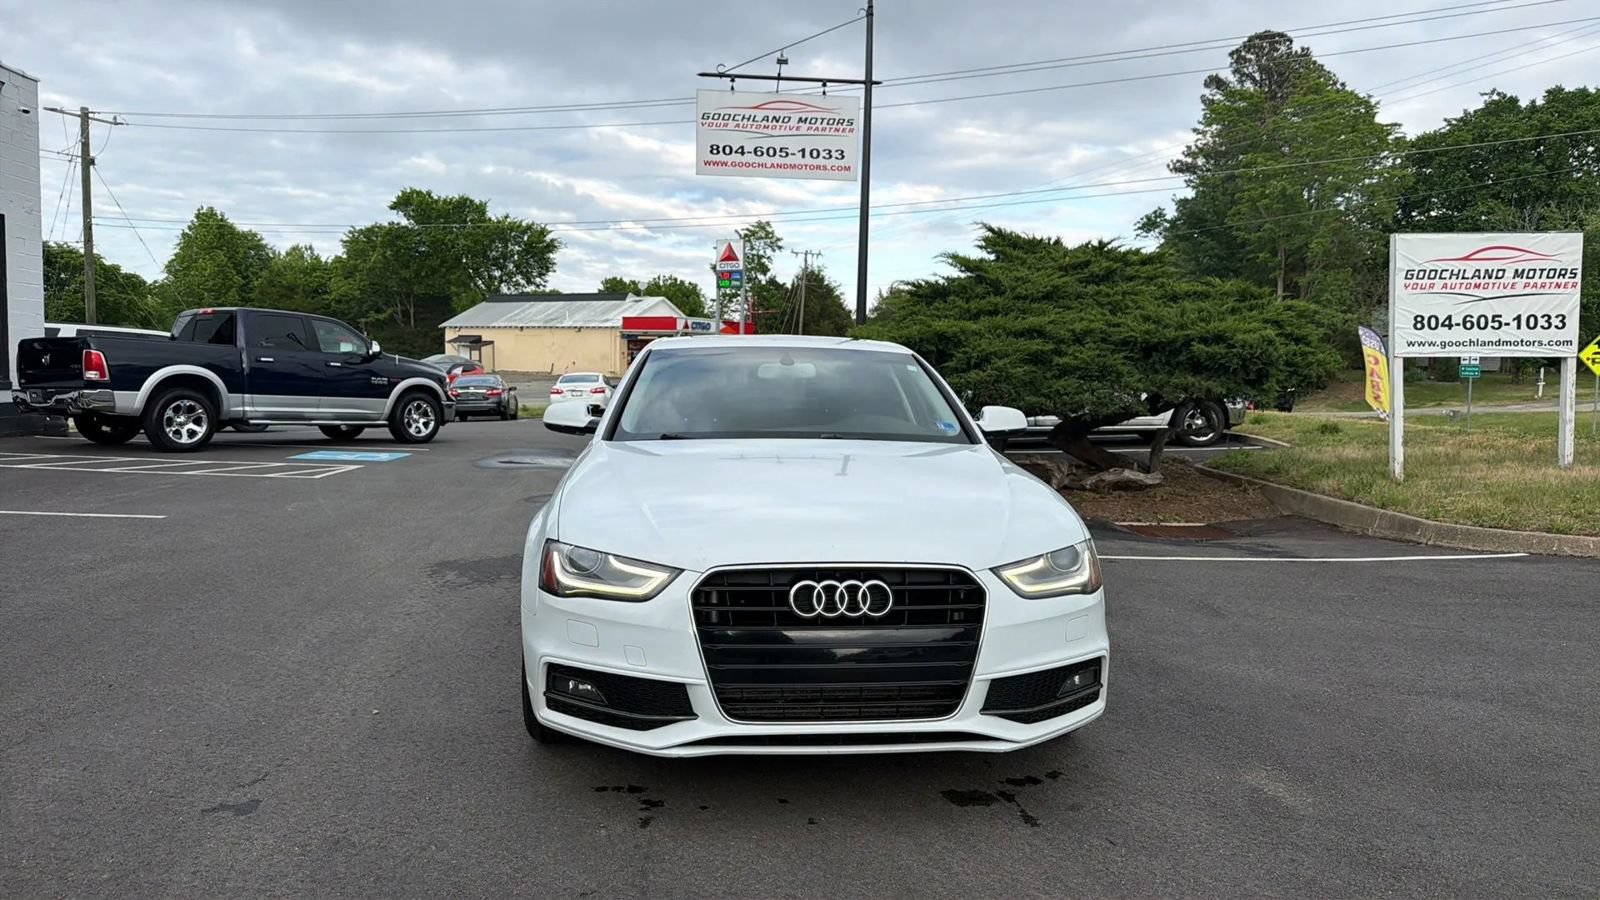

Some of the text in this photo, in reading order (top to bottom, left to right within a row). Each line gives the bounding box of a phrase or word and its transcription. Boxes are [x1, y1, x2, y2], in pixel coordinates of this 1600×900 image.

[701, 112, 855, 127] GOOCHLAND MOTORS
[700, 121, 855, 134] YOUR AUTOMOTIVE PARTNER
[709, 144, 846, 160] 804-605-1033
[703, 160, 851, 172] WWW.GOOCHLANDMOTORS.COM
[1404, 267, 1579, 281] GOOCHLAND MOTORS
[1403, 281, 1579, 291] YOUR AUTOMOTIVE PARTNER
[691, 321, 711, 330] CITGO
[1412, 313, 1567, 331] 804-605-1033
[1406, 338, 1573, 349] www.goochlandmotors.com
